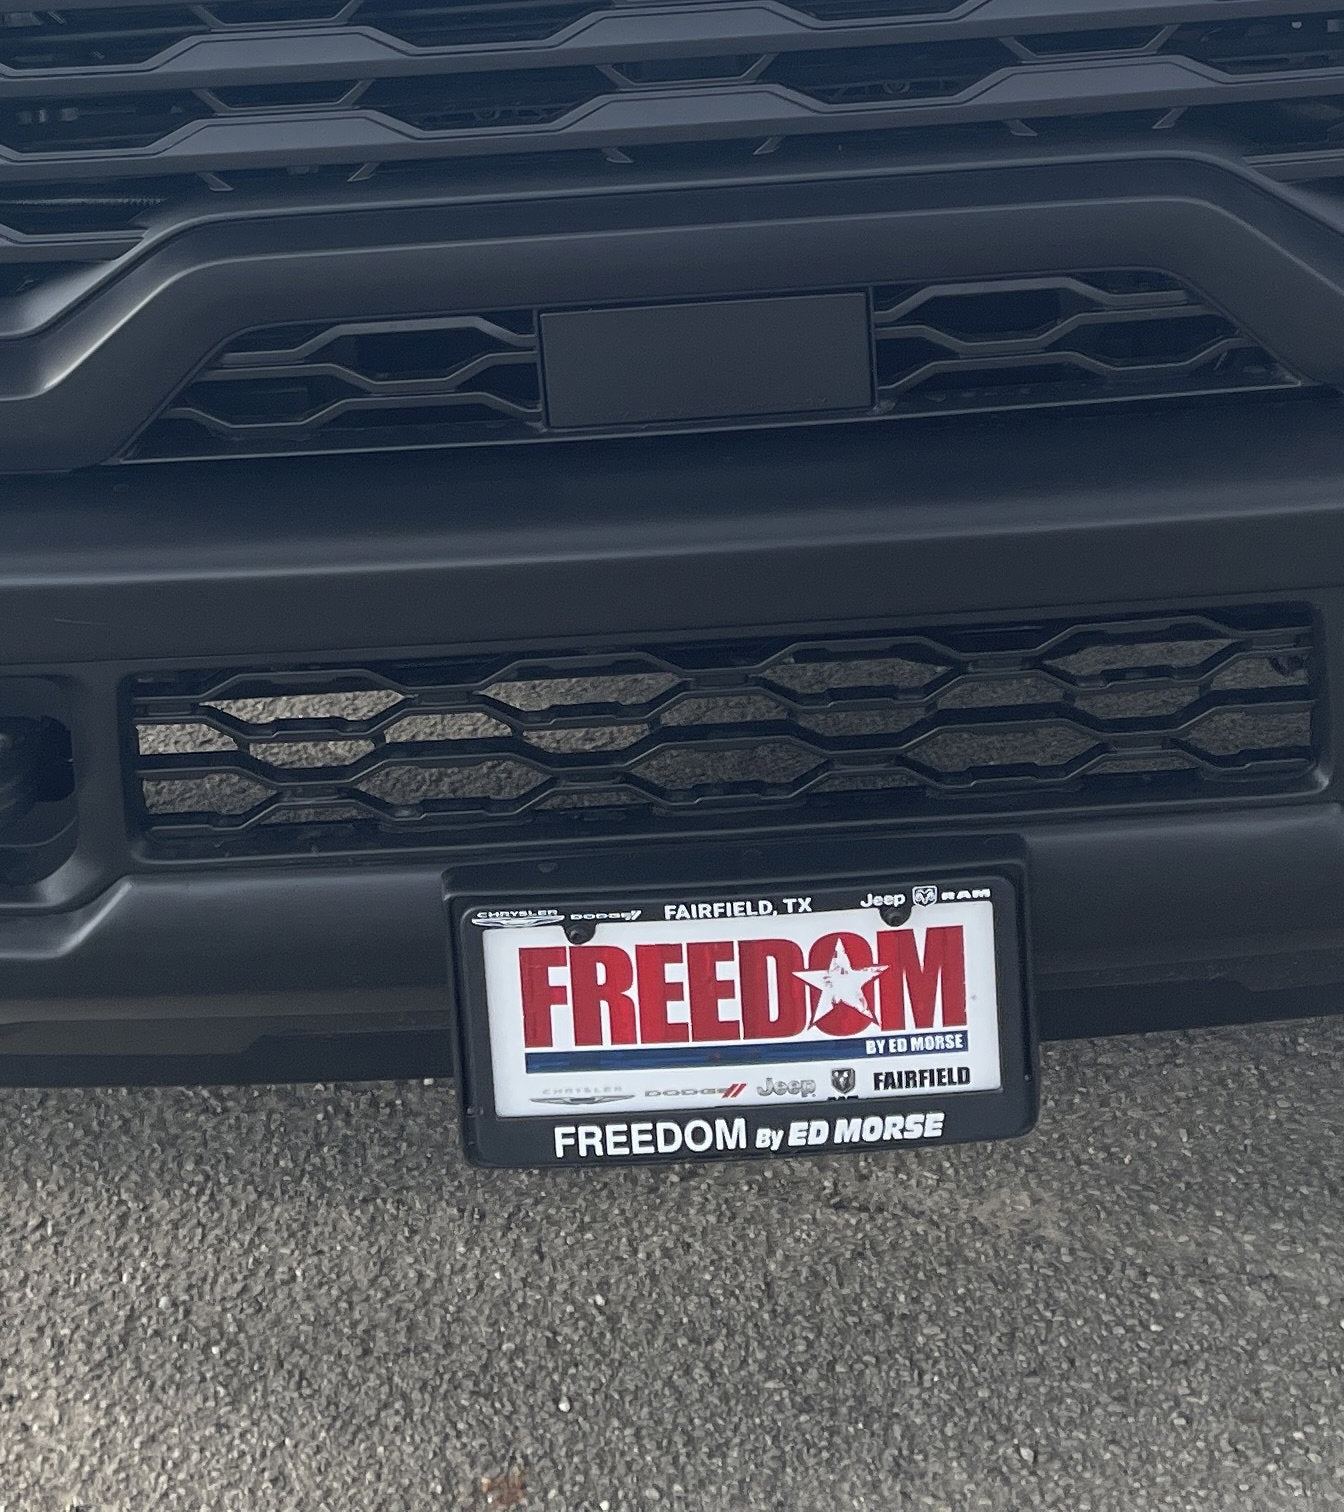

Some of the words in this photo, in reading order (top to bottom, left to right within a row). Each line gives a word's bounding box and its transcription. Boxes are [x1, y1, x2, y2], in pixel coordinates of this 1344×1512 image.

[859, 892, 906, 908] Jeep
[940, 888, 991, 901] RAM
[663, 899, 778, 921] FAIRFIELD,
[783, 897, 813, 914] TX
[518, 925, 968, 1048] FREEDOM
[865, 1038, 887, 1055] BY
[889, 1037, 906, 1053] ED
[910, 1033, 964, 1052] MORSE
[873, 1066, 971, 1091] FAIRFIELD
[554, 1117, 747, 1158] FREEDOM
[755, 1128, 785, 1151] By
[788, 1120, 830, 1146] ED
[833, 1112, 946, 1144] MORSE
